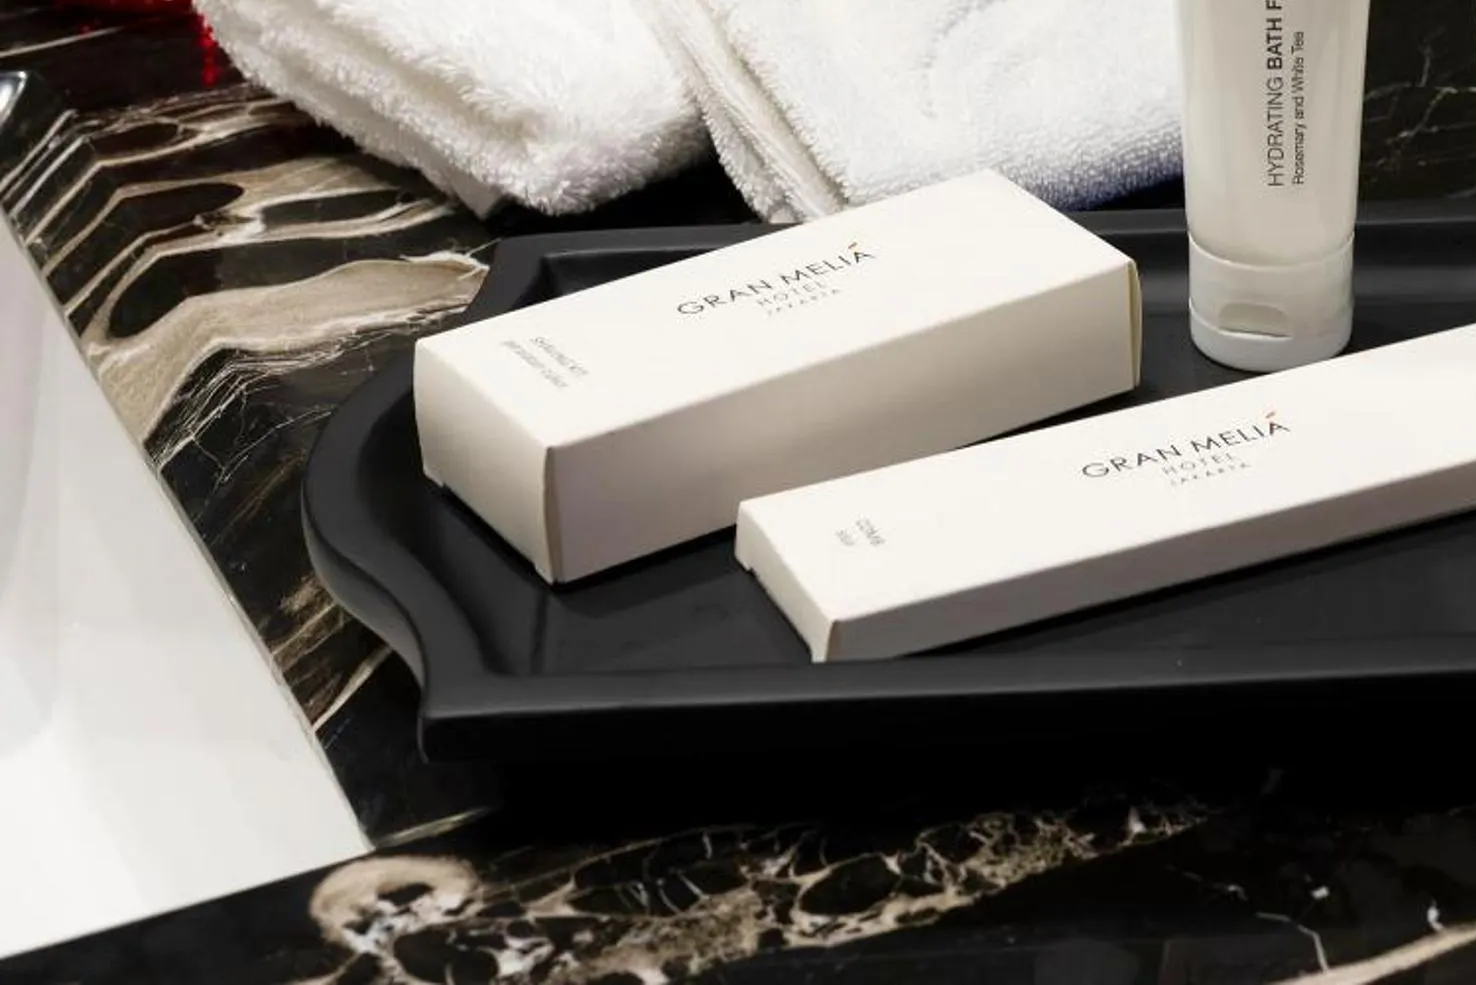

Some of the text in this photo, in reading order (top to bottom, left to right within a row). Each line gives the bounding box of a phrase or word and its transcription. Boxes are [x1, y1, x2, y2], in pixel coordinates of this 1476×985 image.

[1265, 17, 1284, 70] BATH
[1266, 76, 1285, 187] HYDRATING
[1290, 31, 1307, 185] Rosemary and White Tea
[676, 242, 876, 315] GRAN MELIÁ
[756, 281, 830, 307] HOTEL
[1081, 411, 1291, 478] GRAN MELIÁ
[1161, 453, 1240, 476] HOTEL
